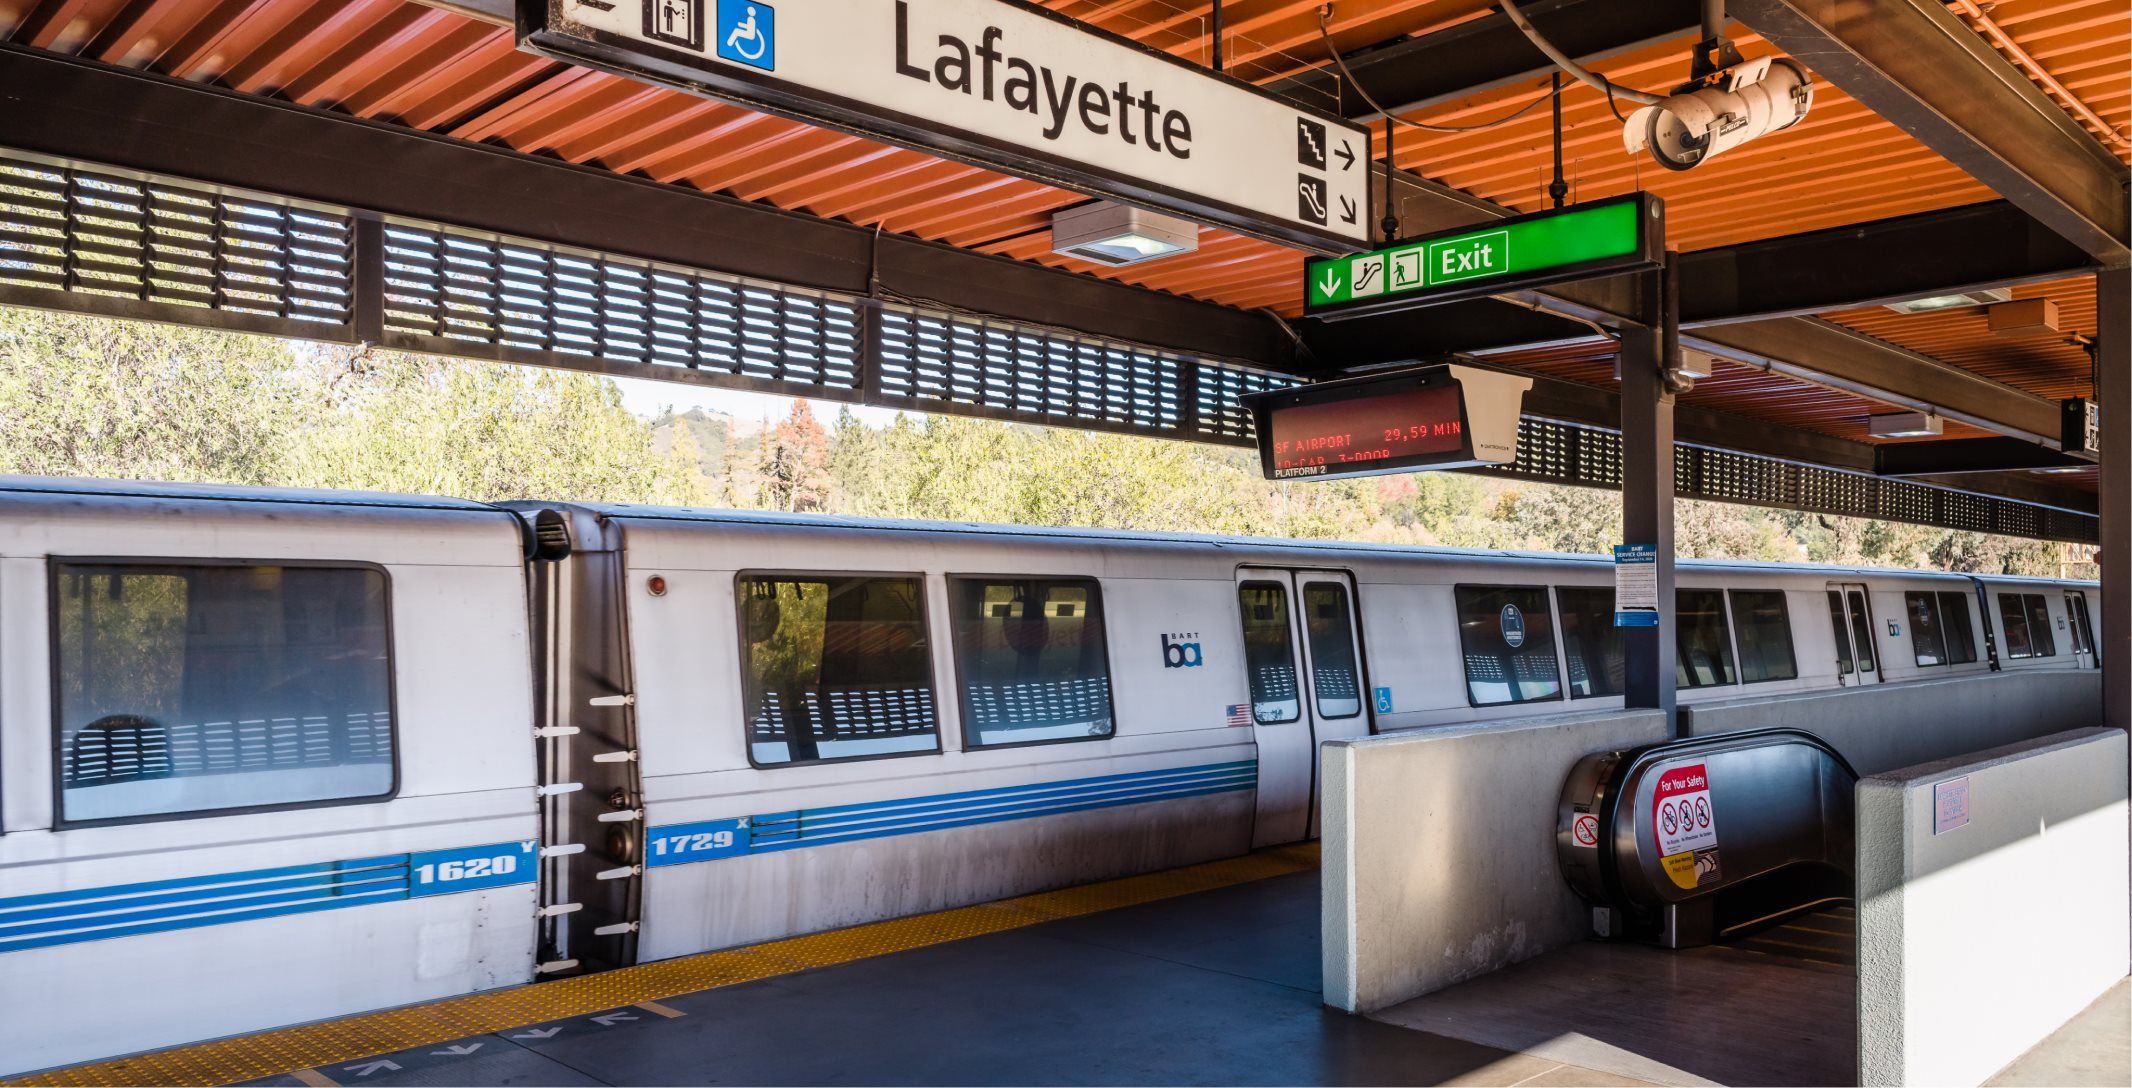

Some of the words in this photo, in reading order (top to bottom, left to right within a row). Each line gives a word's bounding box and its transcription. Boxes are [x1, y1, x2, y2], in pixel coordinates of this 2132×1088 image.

[896, 0, 1192, 159] Lafayette
[1442, 242, 1493, 275] Exit
[1275, 442, 1289, 454] SF
[1296, 434, 1351, 452] AIRPORT
[1384, 424, 1427, 442] 29,59
[1434, 421, 1460, 436] MIN
[1275, 466, 1317, 478] PLATFORM
[1320, 465, 1326, 474] 2
[1661, 780, 1671, 791] For
[1672, 778, 1686, 790] Your
[1686, 774, 1704, 788] Safety
[735, 818, 750, 829] X
[520, 842, 537, 853] Y
[651, 830, 733, 856] 1729
[414, 855, 517, 885] 1620
